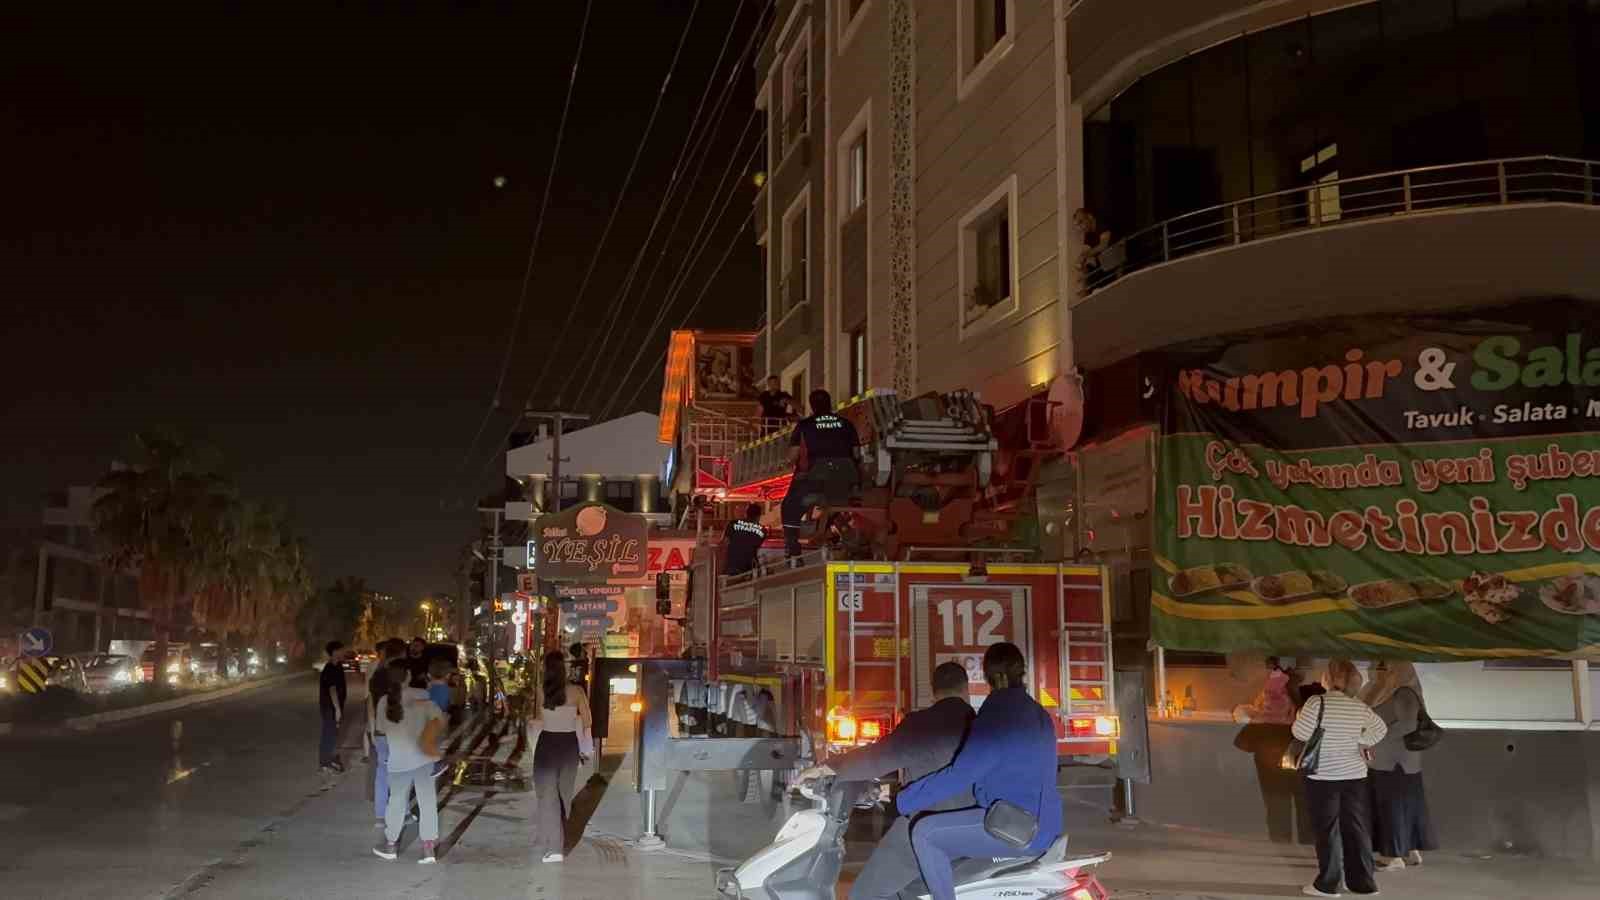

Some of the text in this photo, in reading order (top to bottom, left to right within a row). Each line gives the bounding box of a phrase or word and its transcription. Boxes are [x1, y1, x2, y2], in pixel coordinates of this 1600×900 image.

[1414, 348, 1456, 390] &
[1471, 333, 1600, 391] Sala
[1404, 407, 1474, 429] Tavuk
[1493, 402, 1567, 423] Salata
[1412, 447, 1495, 492] yeni
[543, 534, 639, 571] YEŞİL
[937, 600, 1005, 646] 112
